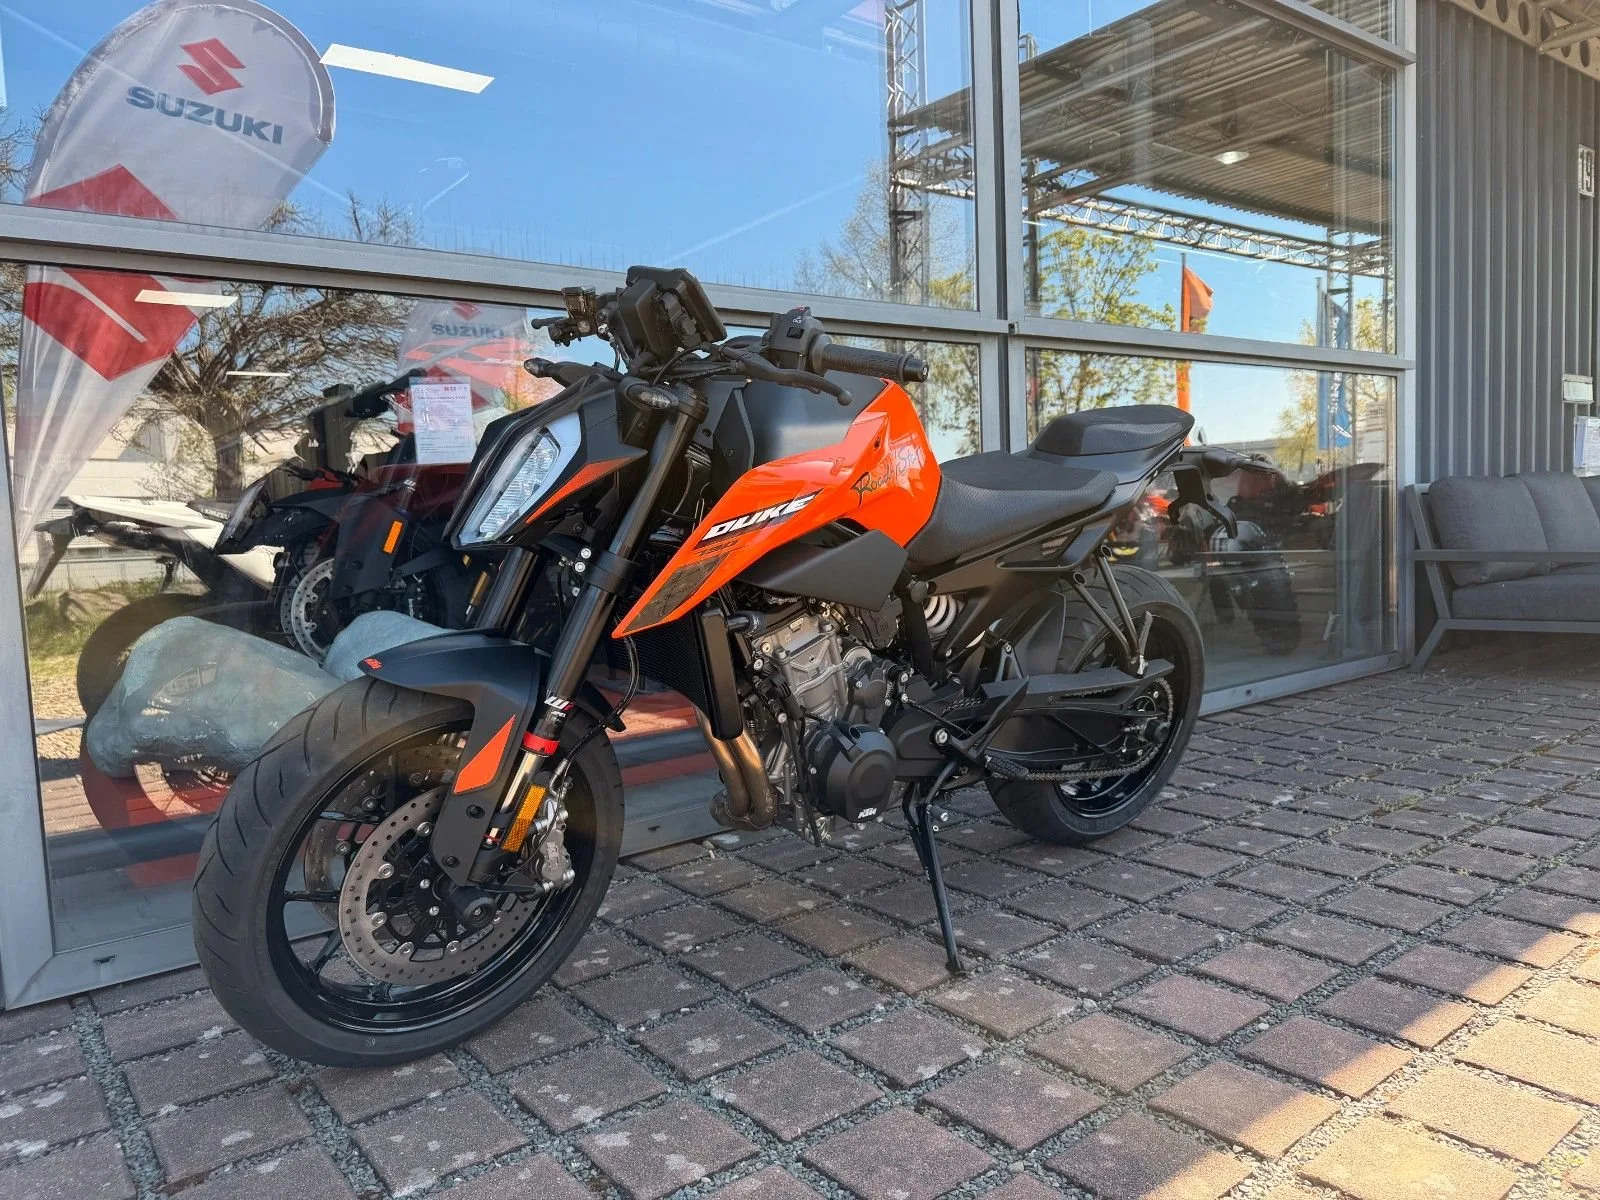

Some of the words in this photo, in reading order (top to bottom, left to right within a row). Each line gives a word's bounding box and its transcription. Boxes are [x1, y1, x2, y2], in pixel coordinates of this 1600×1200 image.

[126, 86, 283, 144] SUZUKI
[1580, 149, 1592, 192] 19
[431, 323, 505, 339] SUZUKI
[701, 494, 816, 541] DUKE
